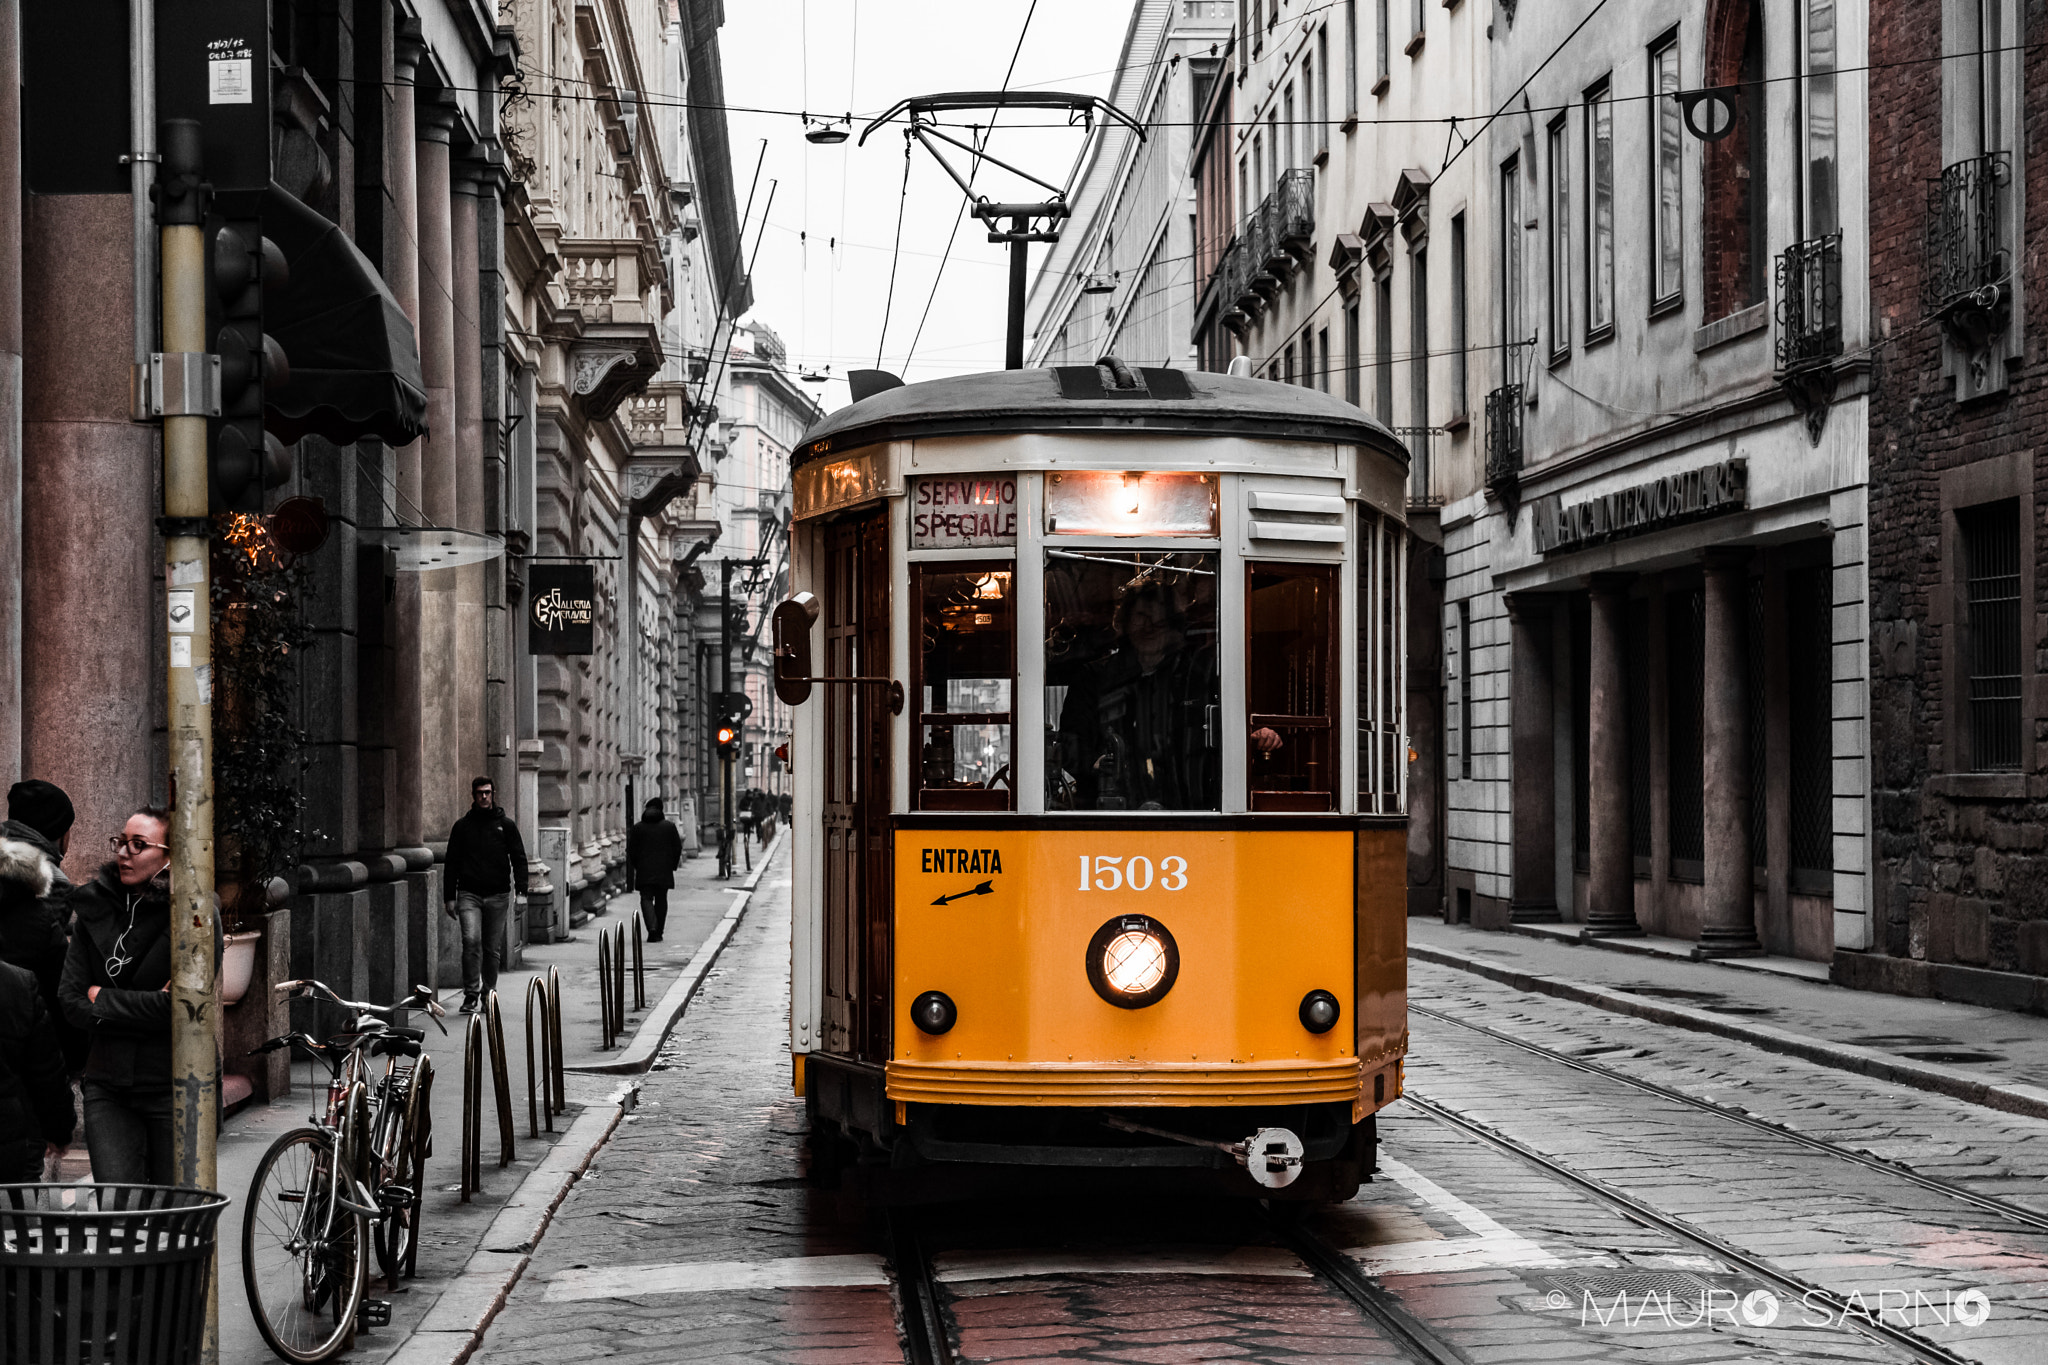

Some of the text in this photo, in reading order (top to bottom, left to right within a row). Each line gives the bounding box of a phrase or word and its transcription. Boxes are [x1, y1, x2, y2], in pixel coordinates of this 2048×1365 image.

[917, 480, 1016, 505] SERVIZIO
[1557, 500, 1603, 545] BANCA
[1600, 458, 1746, 535] INTERMOBILIARE
[915, 513, 1017, 537] SPECIALE
[551, 588, 591, 609] GALLERIA
[922, 848, 1002, 874] ENTRATA
[1078, 855, 1188, 891] 1503
